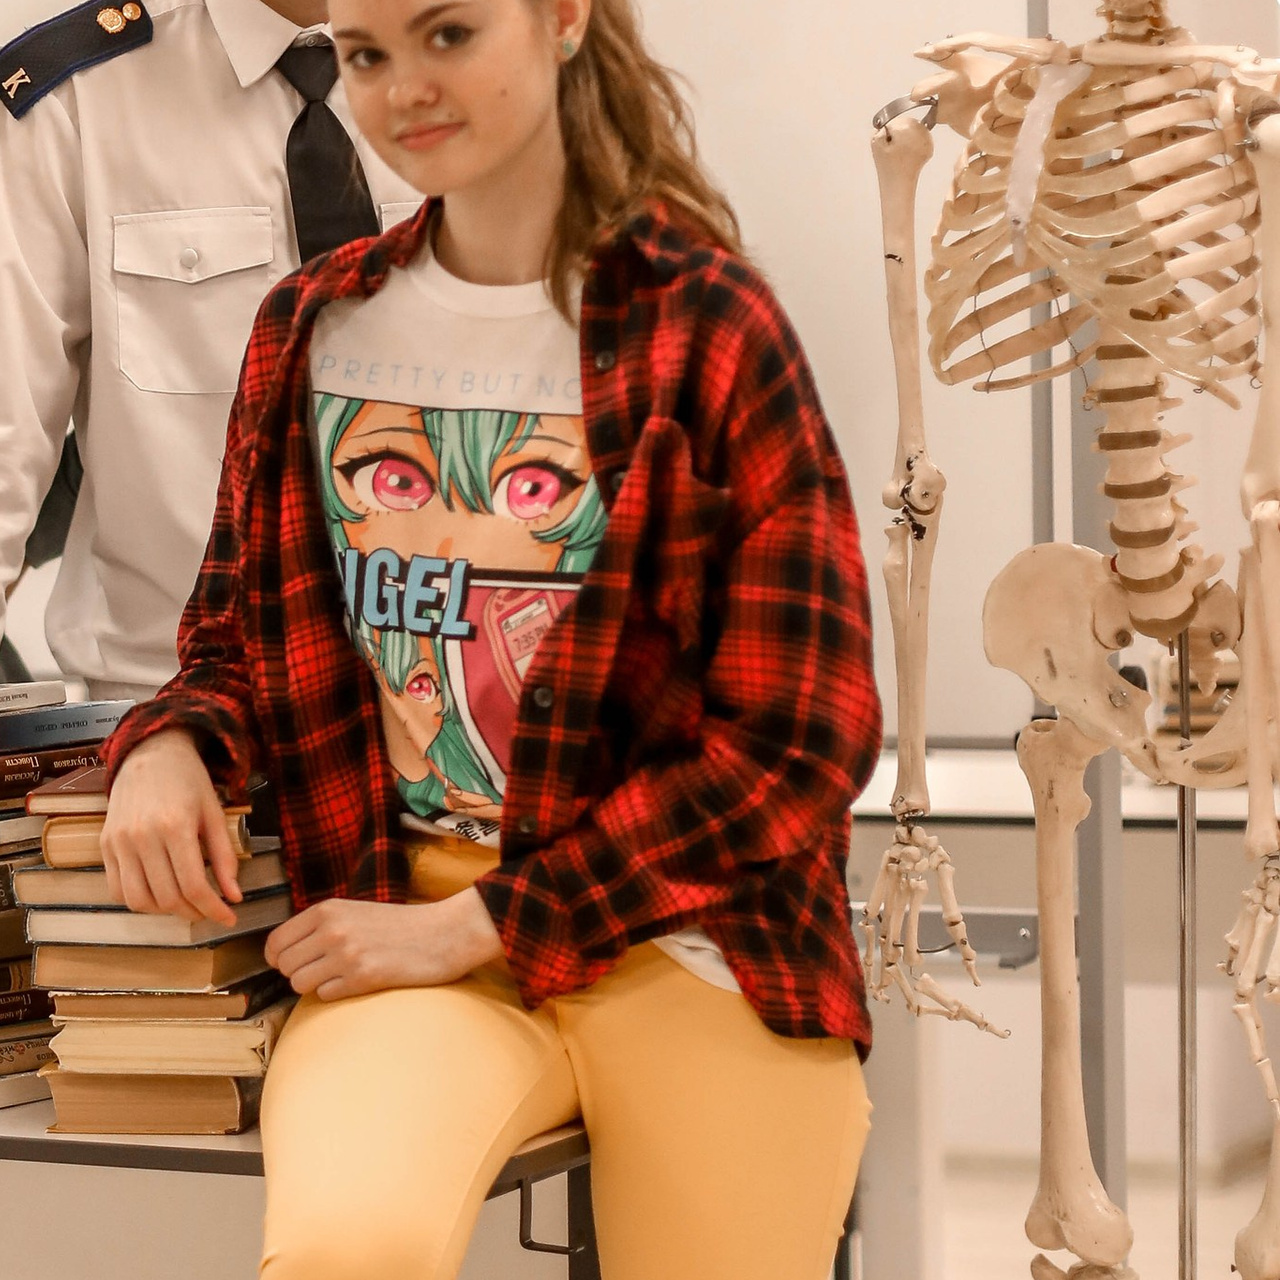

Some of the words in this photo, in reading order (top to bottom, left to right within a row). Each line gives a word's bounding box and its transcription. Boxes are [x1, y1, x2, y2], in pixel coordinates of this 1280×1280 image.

[319, 353, 446, 391] PRETTY
[460, 372, 523, 396] BUT
[5, 755, 40, 769] Повести
[3, 770, 41, 783] Рассказы
